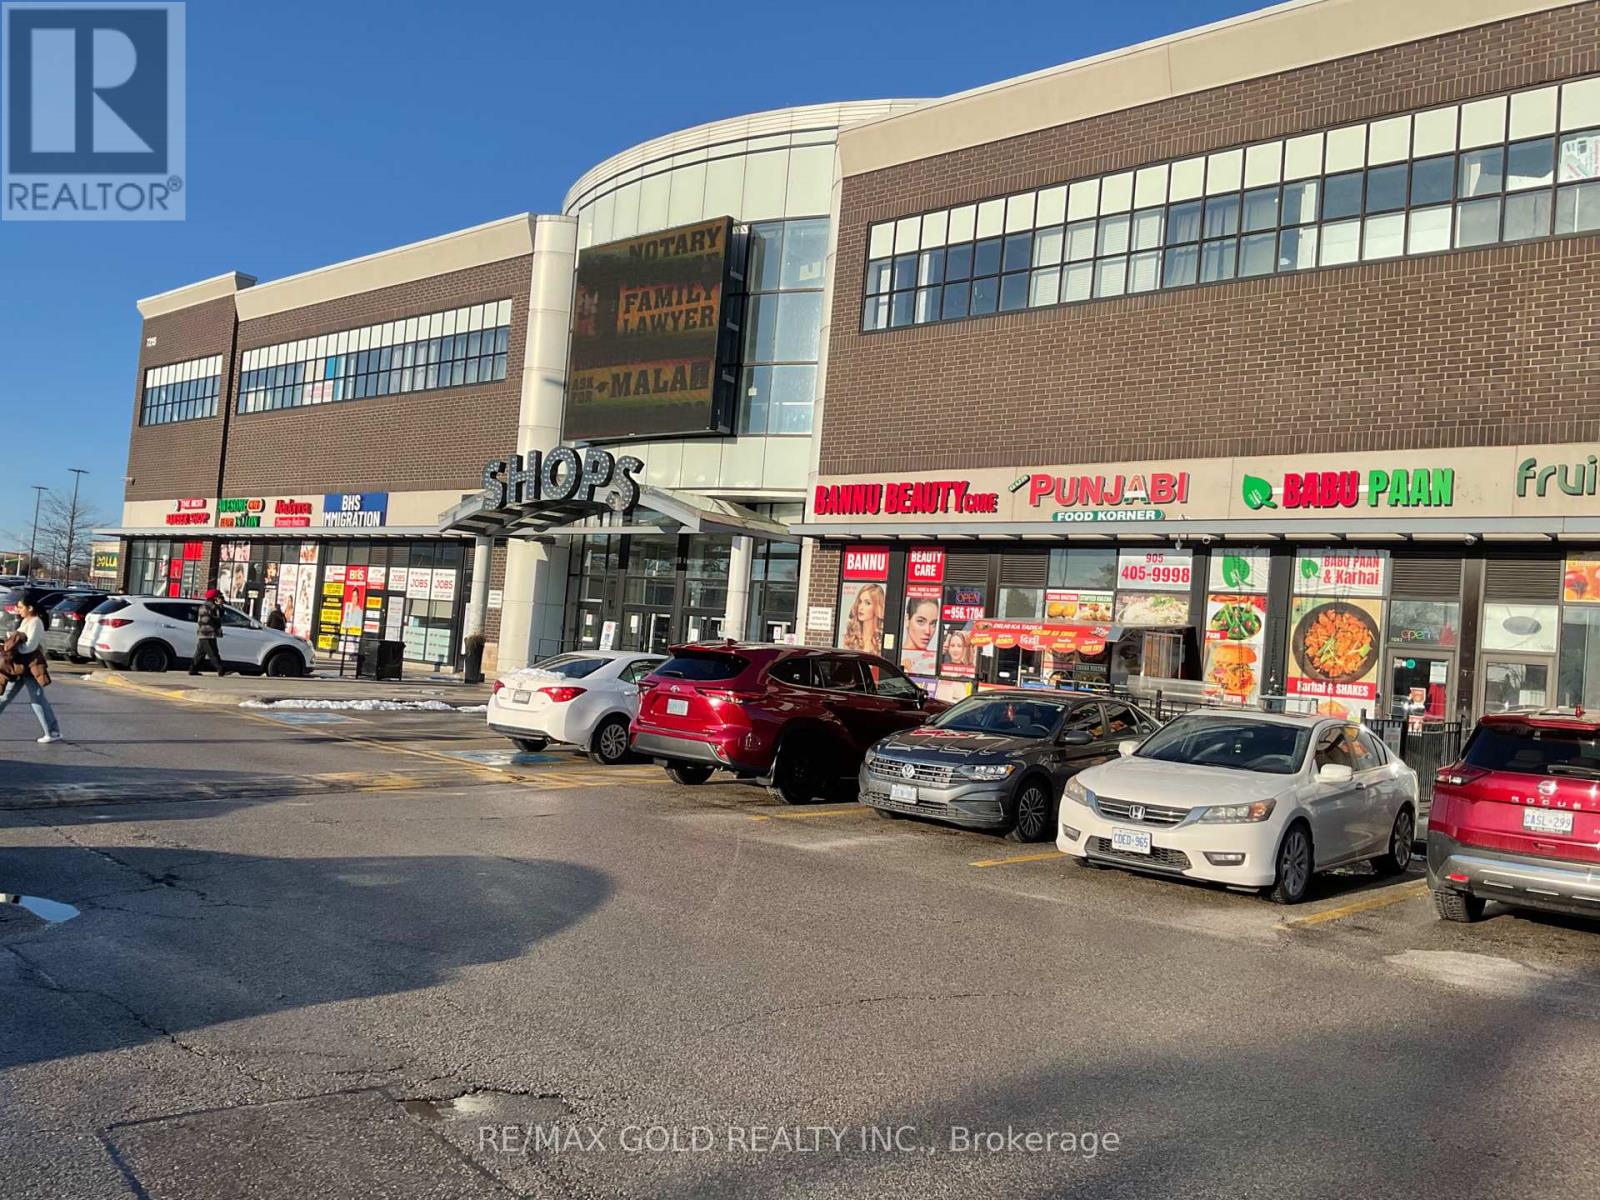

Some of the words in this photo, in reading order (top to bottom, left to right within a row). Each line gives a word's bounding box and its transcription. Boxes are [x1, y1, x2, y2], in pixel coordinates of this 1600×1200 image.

[629, 225, 723, 262] NOTARY
[482, 446, 645, 512] SHOPS
[1029, 471, 1191, 507] PUNJABI
[1283, 470, 1360, 508] BABU
[1368, 467, 1454, 507] PAAN
[342, 495, 361, 511] BHS
[814, 484, 882, 515] BANNU
[884, 481, 969, 514] BEAUTY
[1057, 511, 1094, 522] FOOD
[1097, 510, 1156, 521] KORNER
[846, 553, 886, 570] BANNU
[911, 551, 942, 562] BEAUTY
[1146, 553, 1164, 563] 905
[1323, 556, 1349, 567] BABU
[1353, 556, 1379, 567] PAAN
[914, 564, 936, 576] CARE
[1121, 565, 1191, 583] 405-9998
[1323, 571, 1332, 584] &
[1335, 569, 1379, 585] Karhai
[410, 579, 428, 588] JOBS
[434, 580, 453, 589] JOBS
[1401, 628, 1432, 640] open
[1336, 684, 1369, 697] SHAKES
